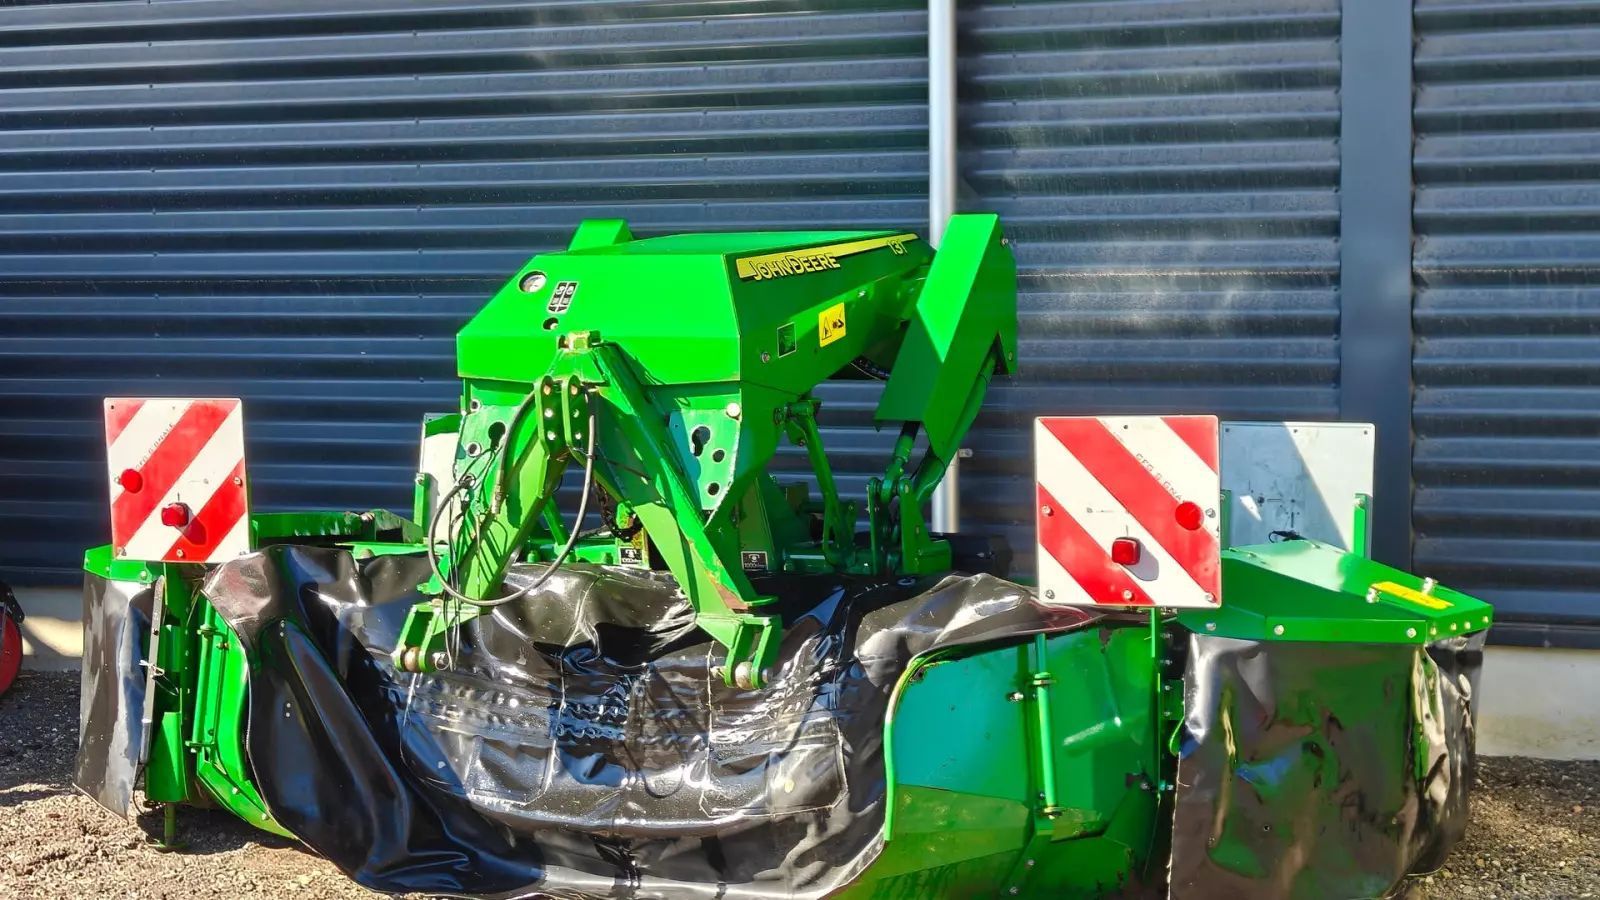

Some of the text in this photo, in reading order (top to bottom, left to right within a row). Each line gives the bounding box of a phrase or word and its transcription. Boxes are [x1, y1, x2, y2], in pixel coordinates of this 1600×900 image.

[886, 238, 908, 254] 131
[749, 253, 841, 281] JOHN DEERE
